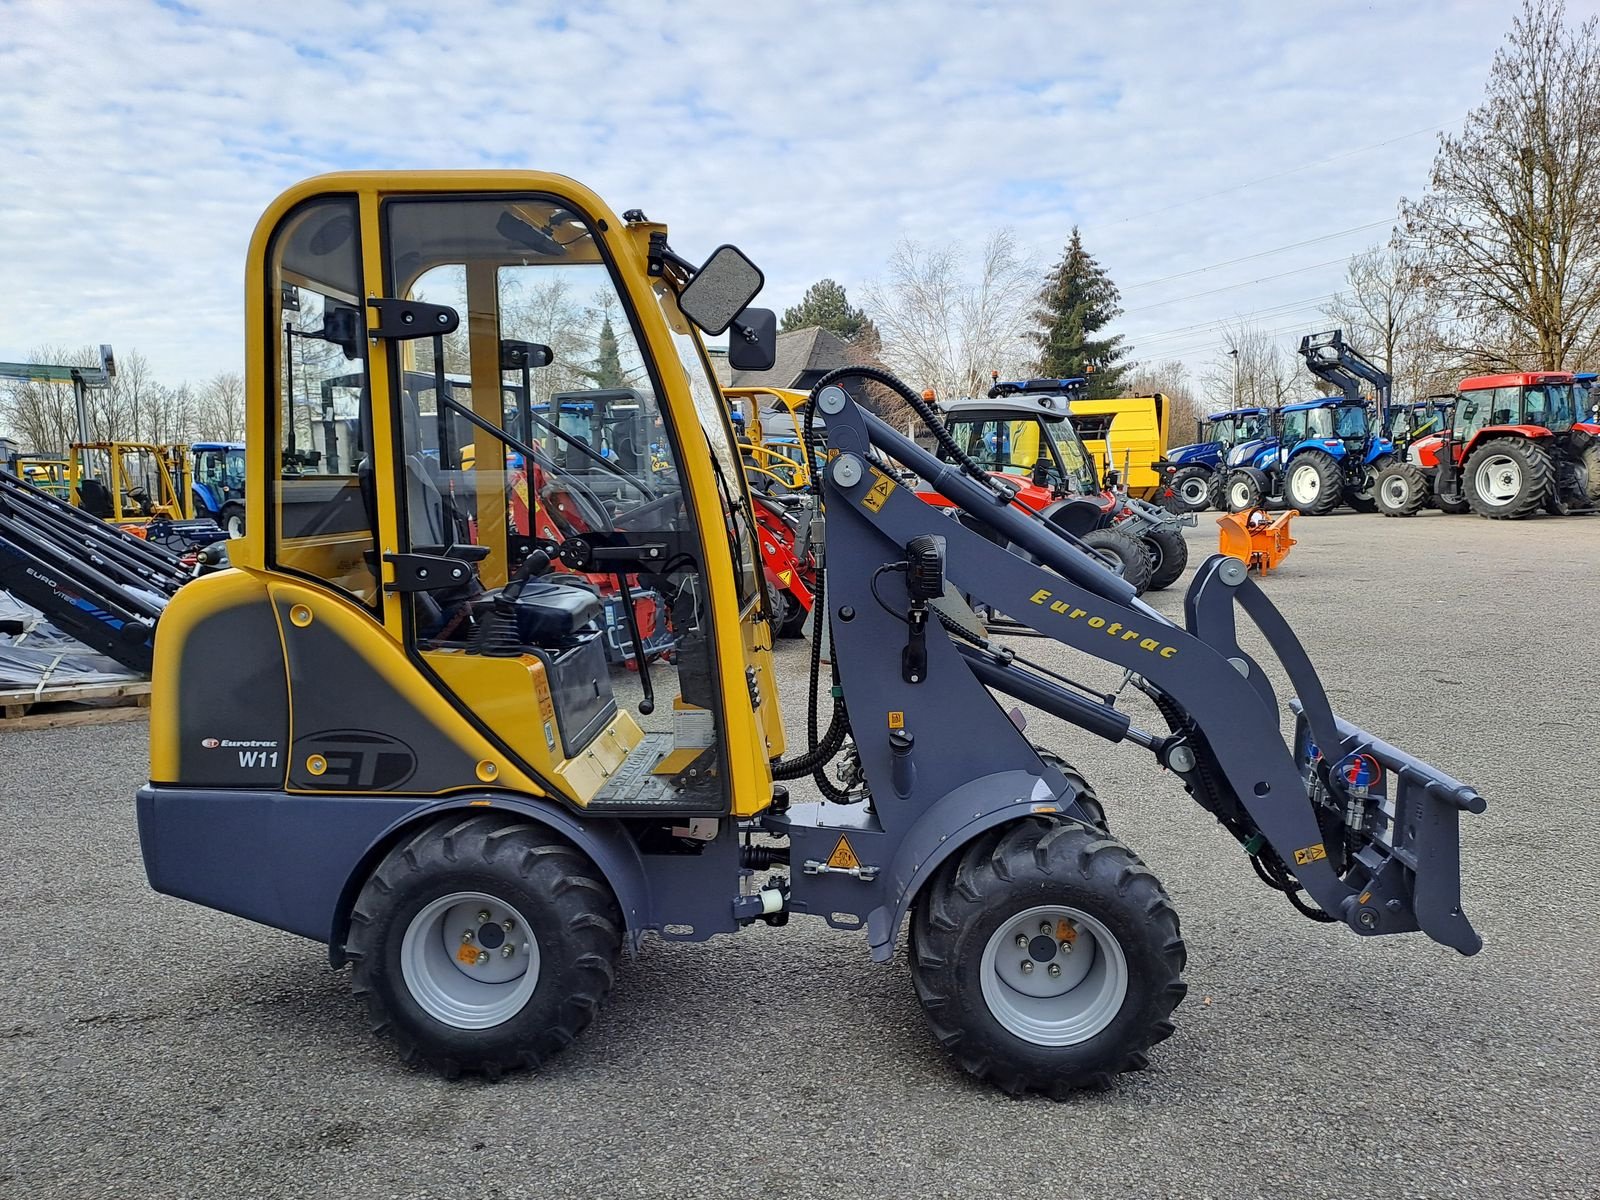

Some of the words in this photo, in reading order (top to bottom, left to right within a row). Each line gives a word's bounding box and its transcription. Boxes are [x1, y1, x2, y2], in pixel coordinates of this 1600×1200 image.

[26, 567, 57, 588] EURO
[1029, 588, 1178, 659] Eurotrac
[220, 739, 278, 747] Eurotrac
[238, 751, 278, 768] W11
